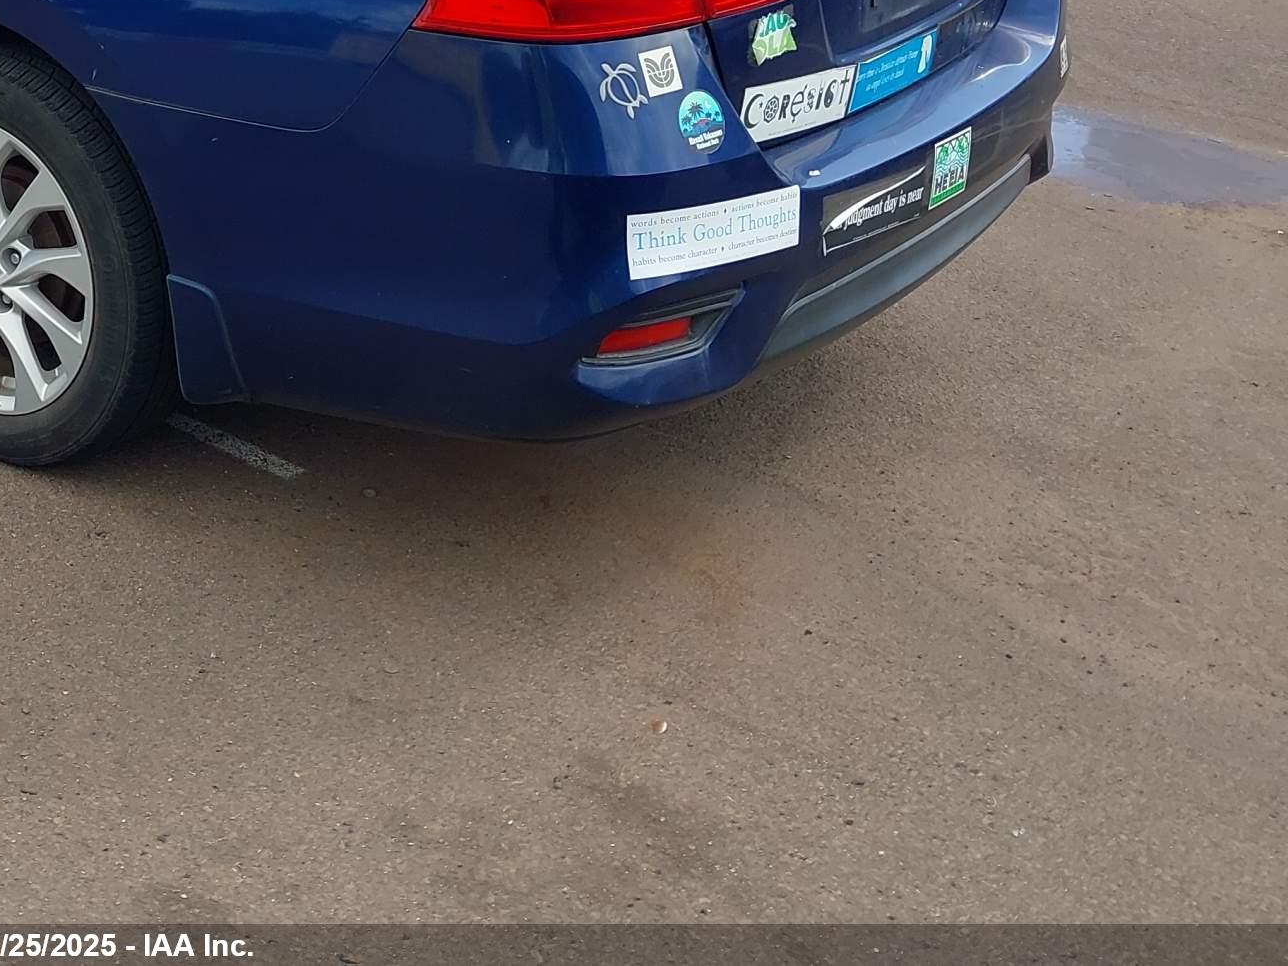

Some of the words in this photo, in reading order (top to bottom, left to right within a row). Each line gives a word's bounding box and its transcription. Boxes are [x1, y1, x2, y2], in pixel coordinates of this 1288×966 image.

[630, 217, 657, 228] words
[660, 213, 690, 225] become
[693, 209, 720, 221] actions
[731, 202, 754, 213] actions
[756, 197, 779, 208] become
[780, 191, 798, 202] habits
[883, 194, 898, 213] day
[898, 189, 906, 207] is
[907, 187, 924, 203] near
[632, 226, 688, 251] Think
[693, 217, 733, 242] Good
[737, 206, 797, 233] Thoughts
[632, 257, 657, 267] habits
[659, 252, 686, 263] become
[687, 245, 718, 259] character
[728, 239, 755, 251] character
[756, 233, 779, 244] becomes
